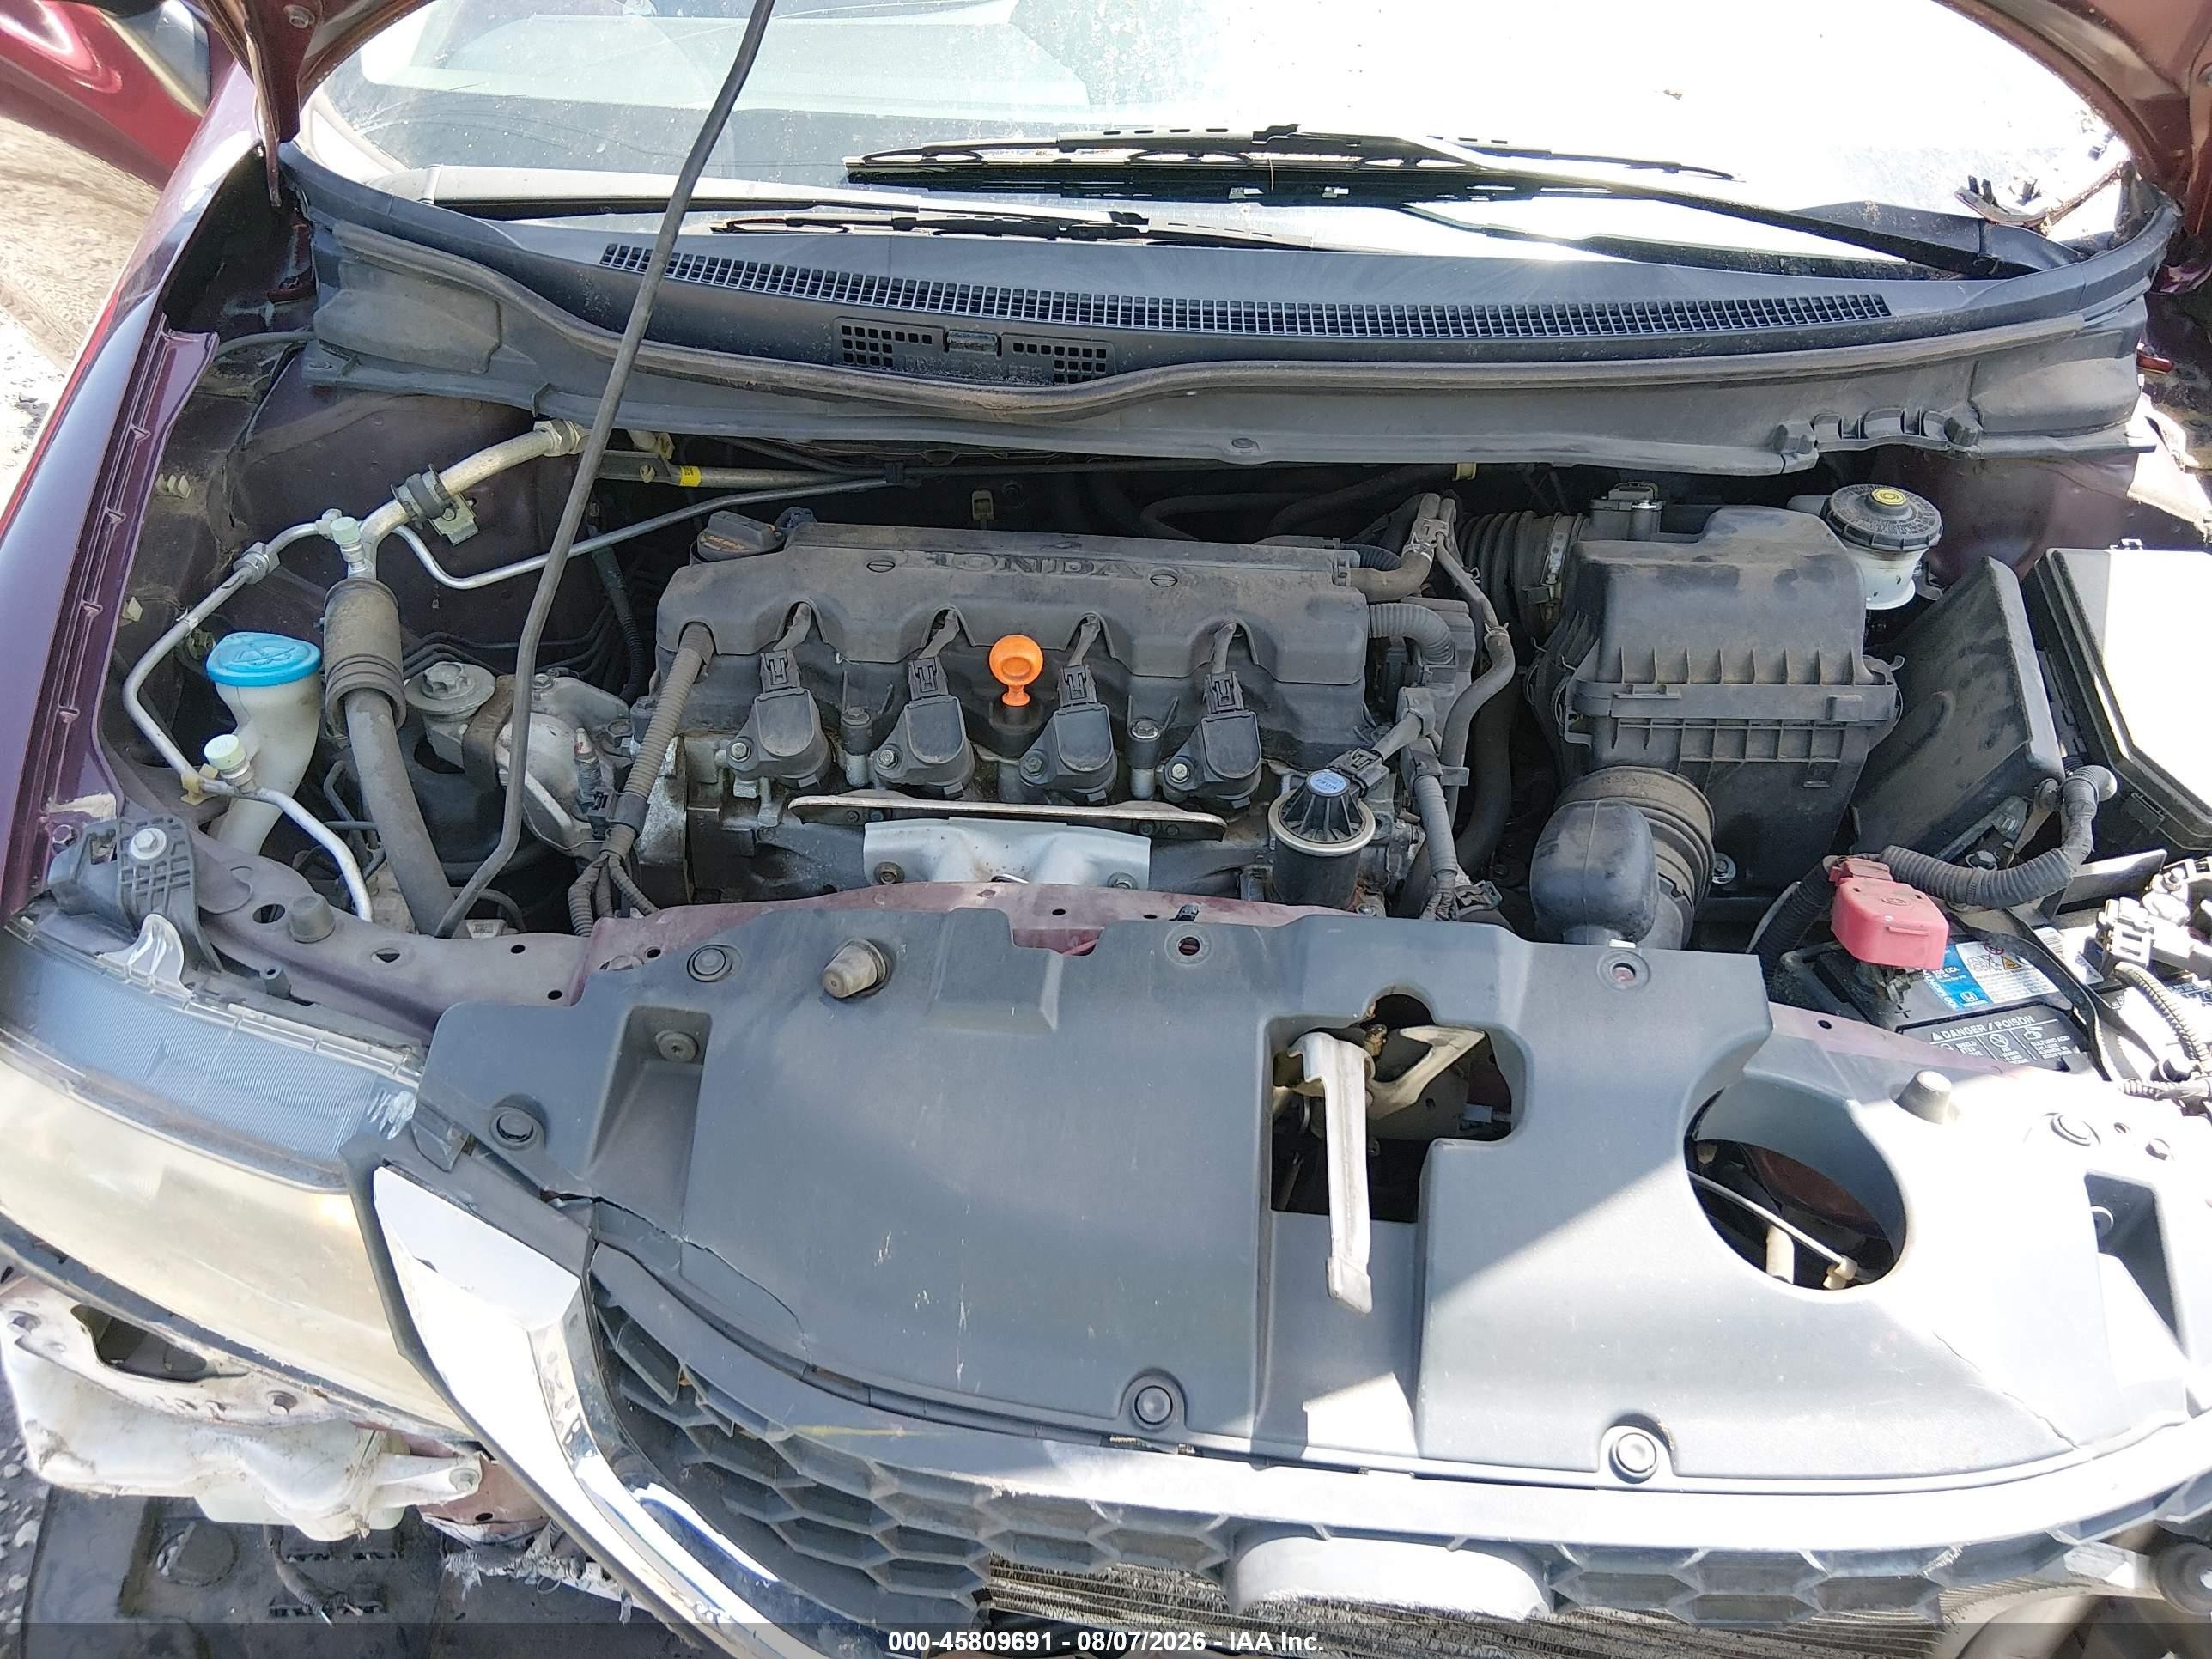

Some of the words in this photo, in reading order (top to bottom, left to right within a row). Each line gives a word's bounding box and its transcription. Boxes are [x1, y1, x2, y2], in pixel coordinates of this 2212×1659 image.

[902, 551, 1144, 580] HONDA
[1941, 1024, 1987, 1039] DANGER
[1995, 1015, 2036, 1030] POISON
